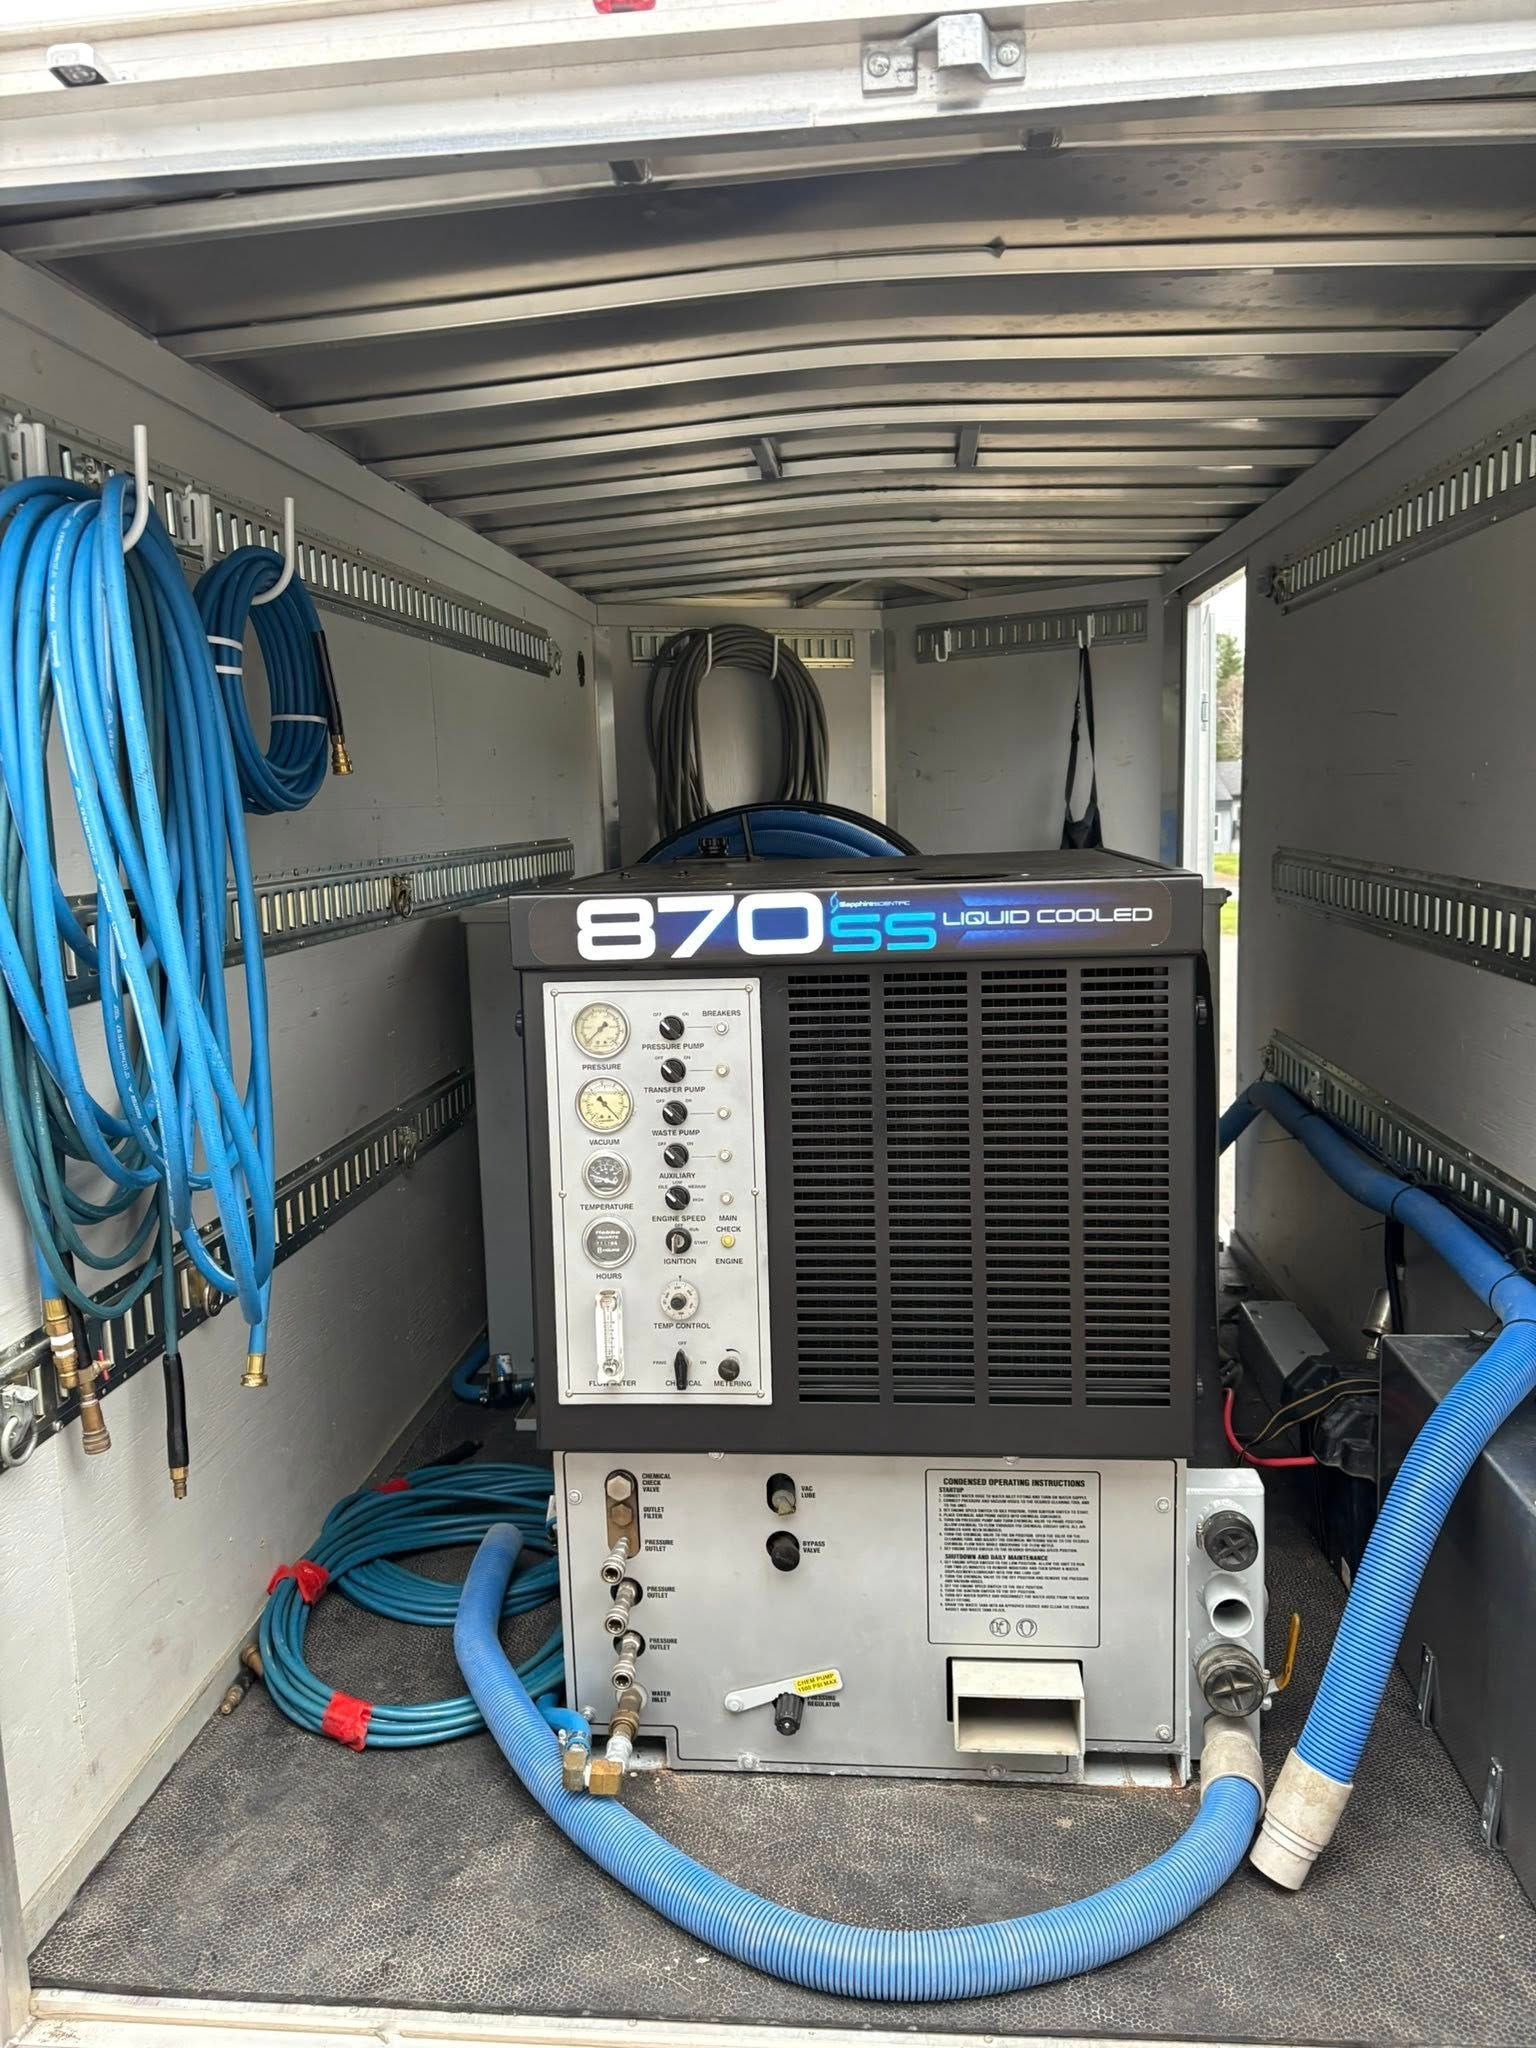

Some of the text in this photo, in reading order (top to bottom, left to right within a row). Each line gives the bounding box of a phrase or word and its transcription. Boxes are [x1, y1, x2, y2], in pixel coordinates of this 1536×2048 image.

[576, 892, 1153, 962] 870 SS LIQUID COOLED
[943, 1478, 1086, 1488] CONDENSED OPERATING INSTRUCTIONS
[796, 1672, 834, 1686] CHEM PUMP
[824, 1678, 837, 1686] MAX
